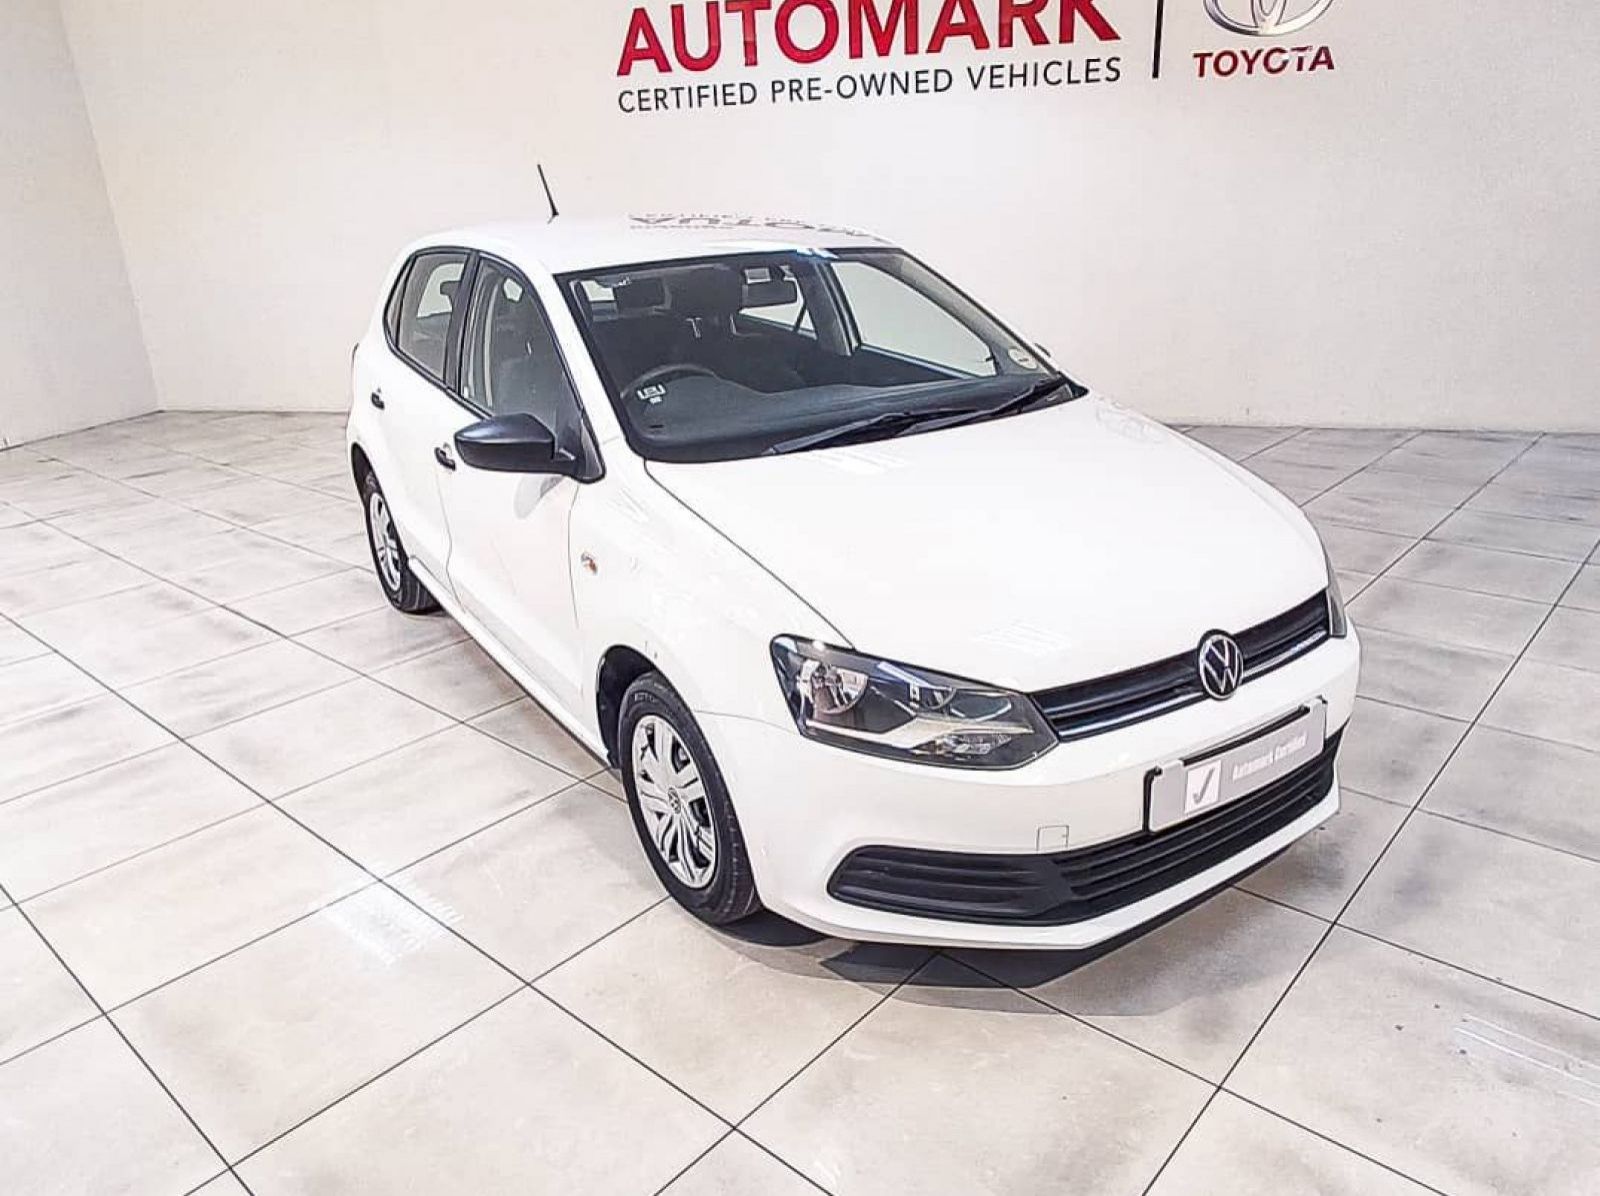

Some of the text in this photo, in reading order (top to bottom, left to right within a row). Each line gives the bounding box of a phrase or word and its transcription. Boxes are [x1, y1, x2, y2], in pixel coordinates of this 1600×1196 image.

[617, 0, 1121, 76] AUTOMARK
[1193, 46, 1335, 78] TOYOTA
[618, 57, 1121, 113] CERTIFIED PRE-OWNED VEHICLES
